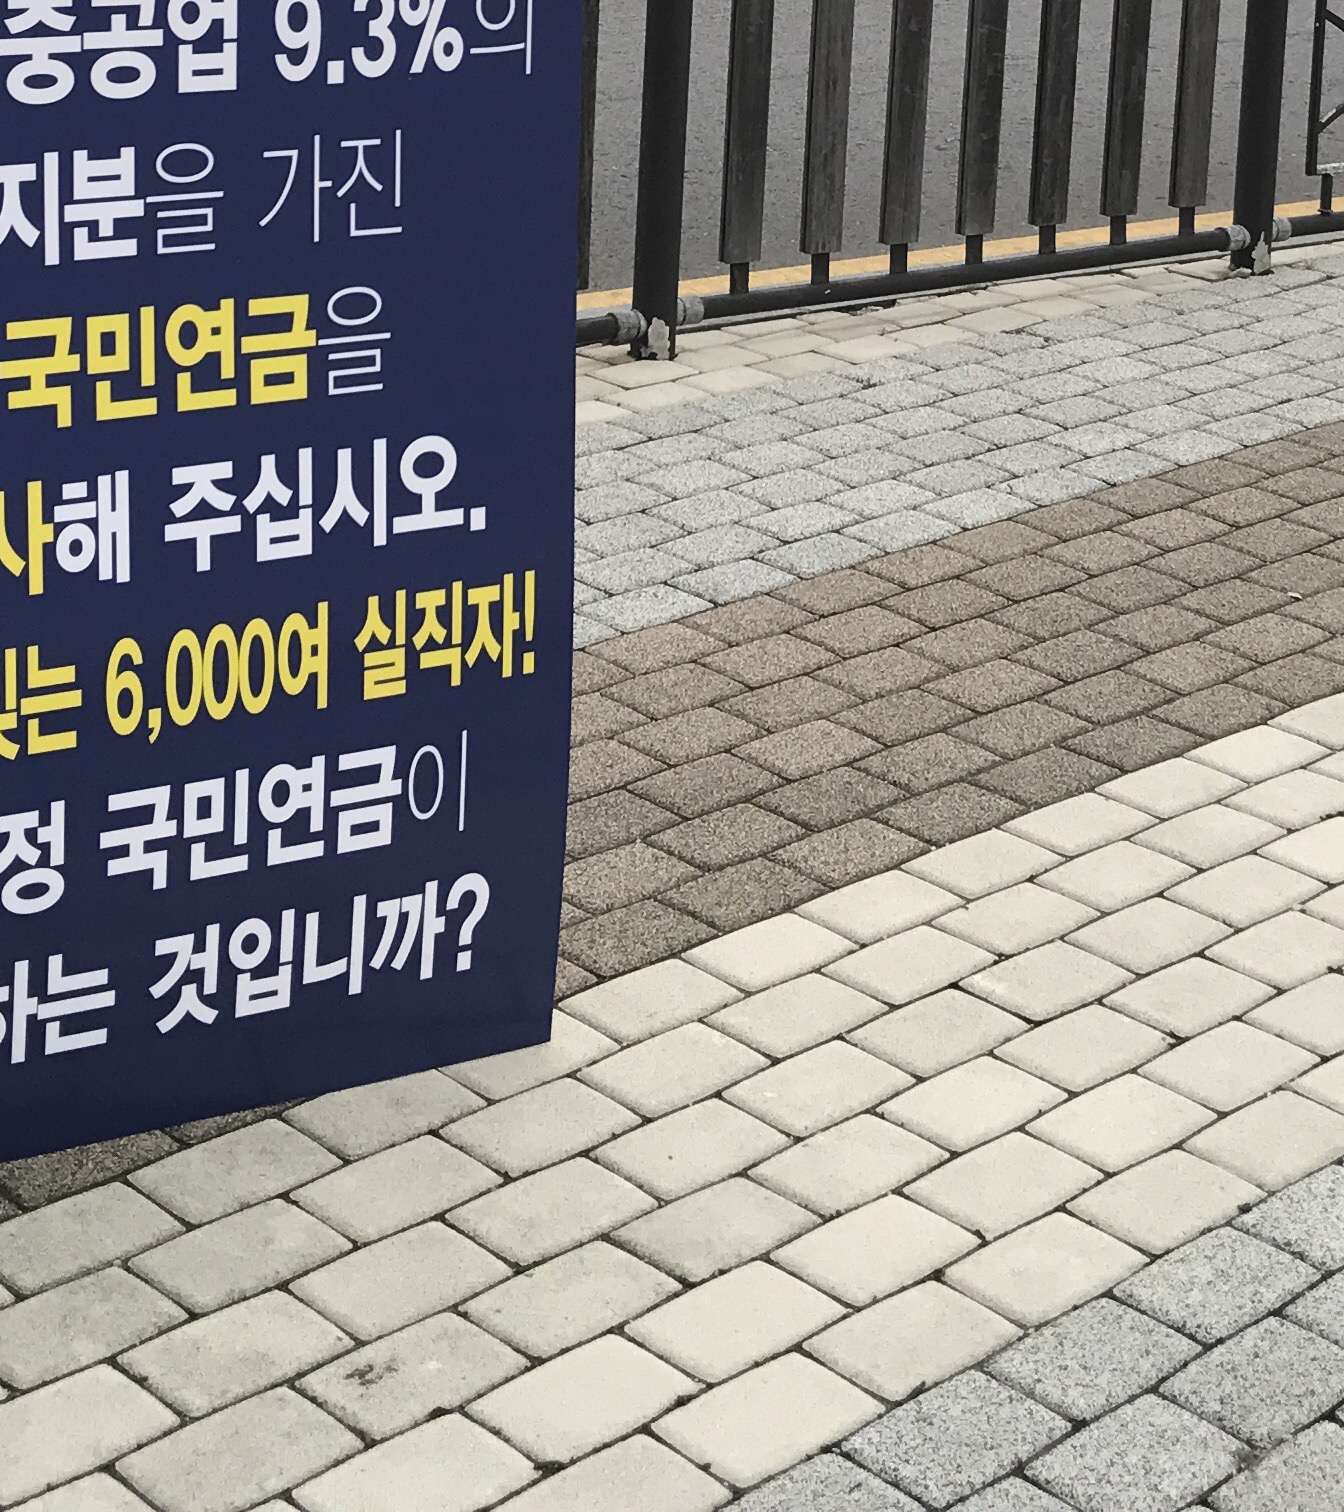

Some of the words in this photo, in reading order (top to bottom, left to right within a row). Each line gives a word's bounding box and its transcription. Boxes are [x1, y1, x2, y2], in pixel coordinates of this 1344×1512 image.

[259, 130, 402, 242] 가진
[0, 287, 391, 428] 국민연금을
[165, 436, 486, 572] 주십시오.
[106, 601, 328, 743] 6,000여
[354, 570, 535, 700] 실직자!
[100, 730, 467, 890] 국민연금이
[149, 873, 489, 1033] 것입니까?
